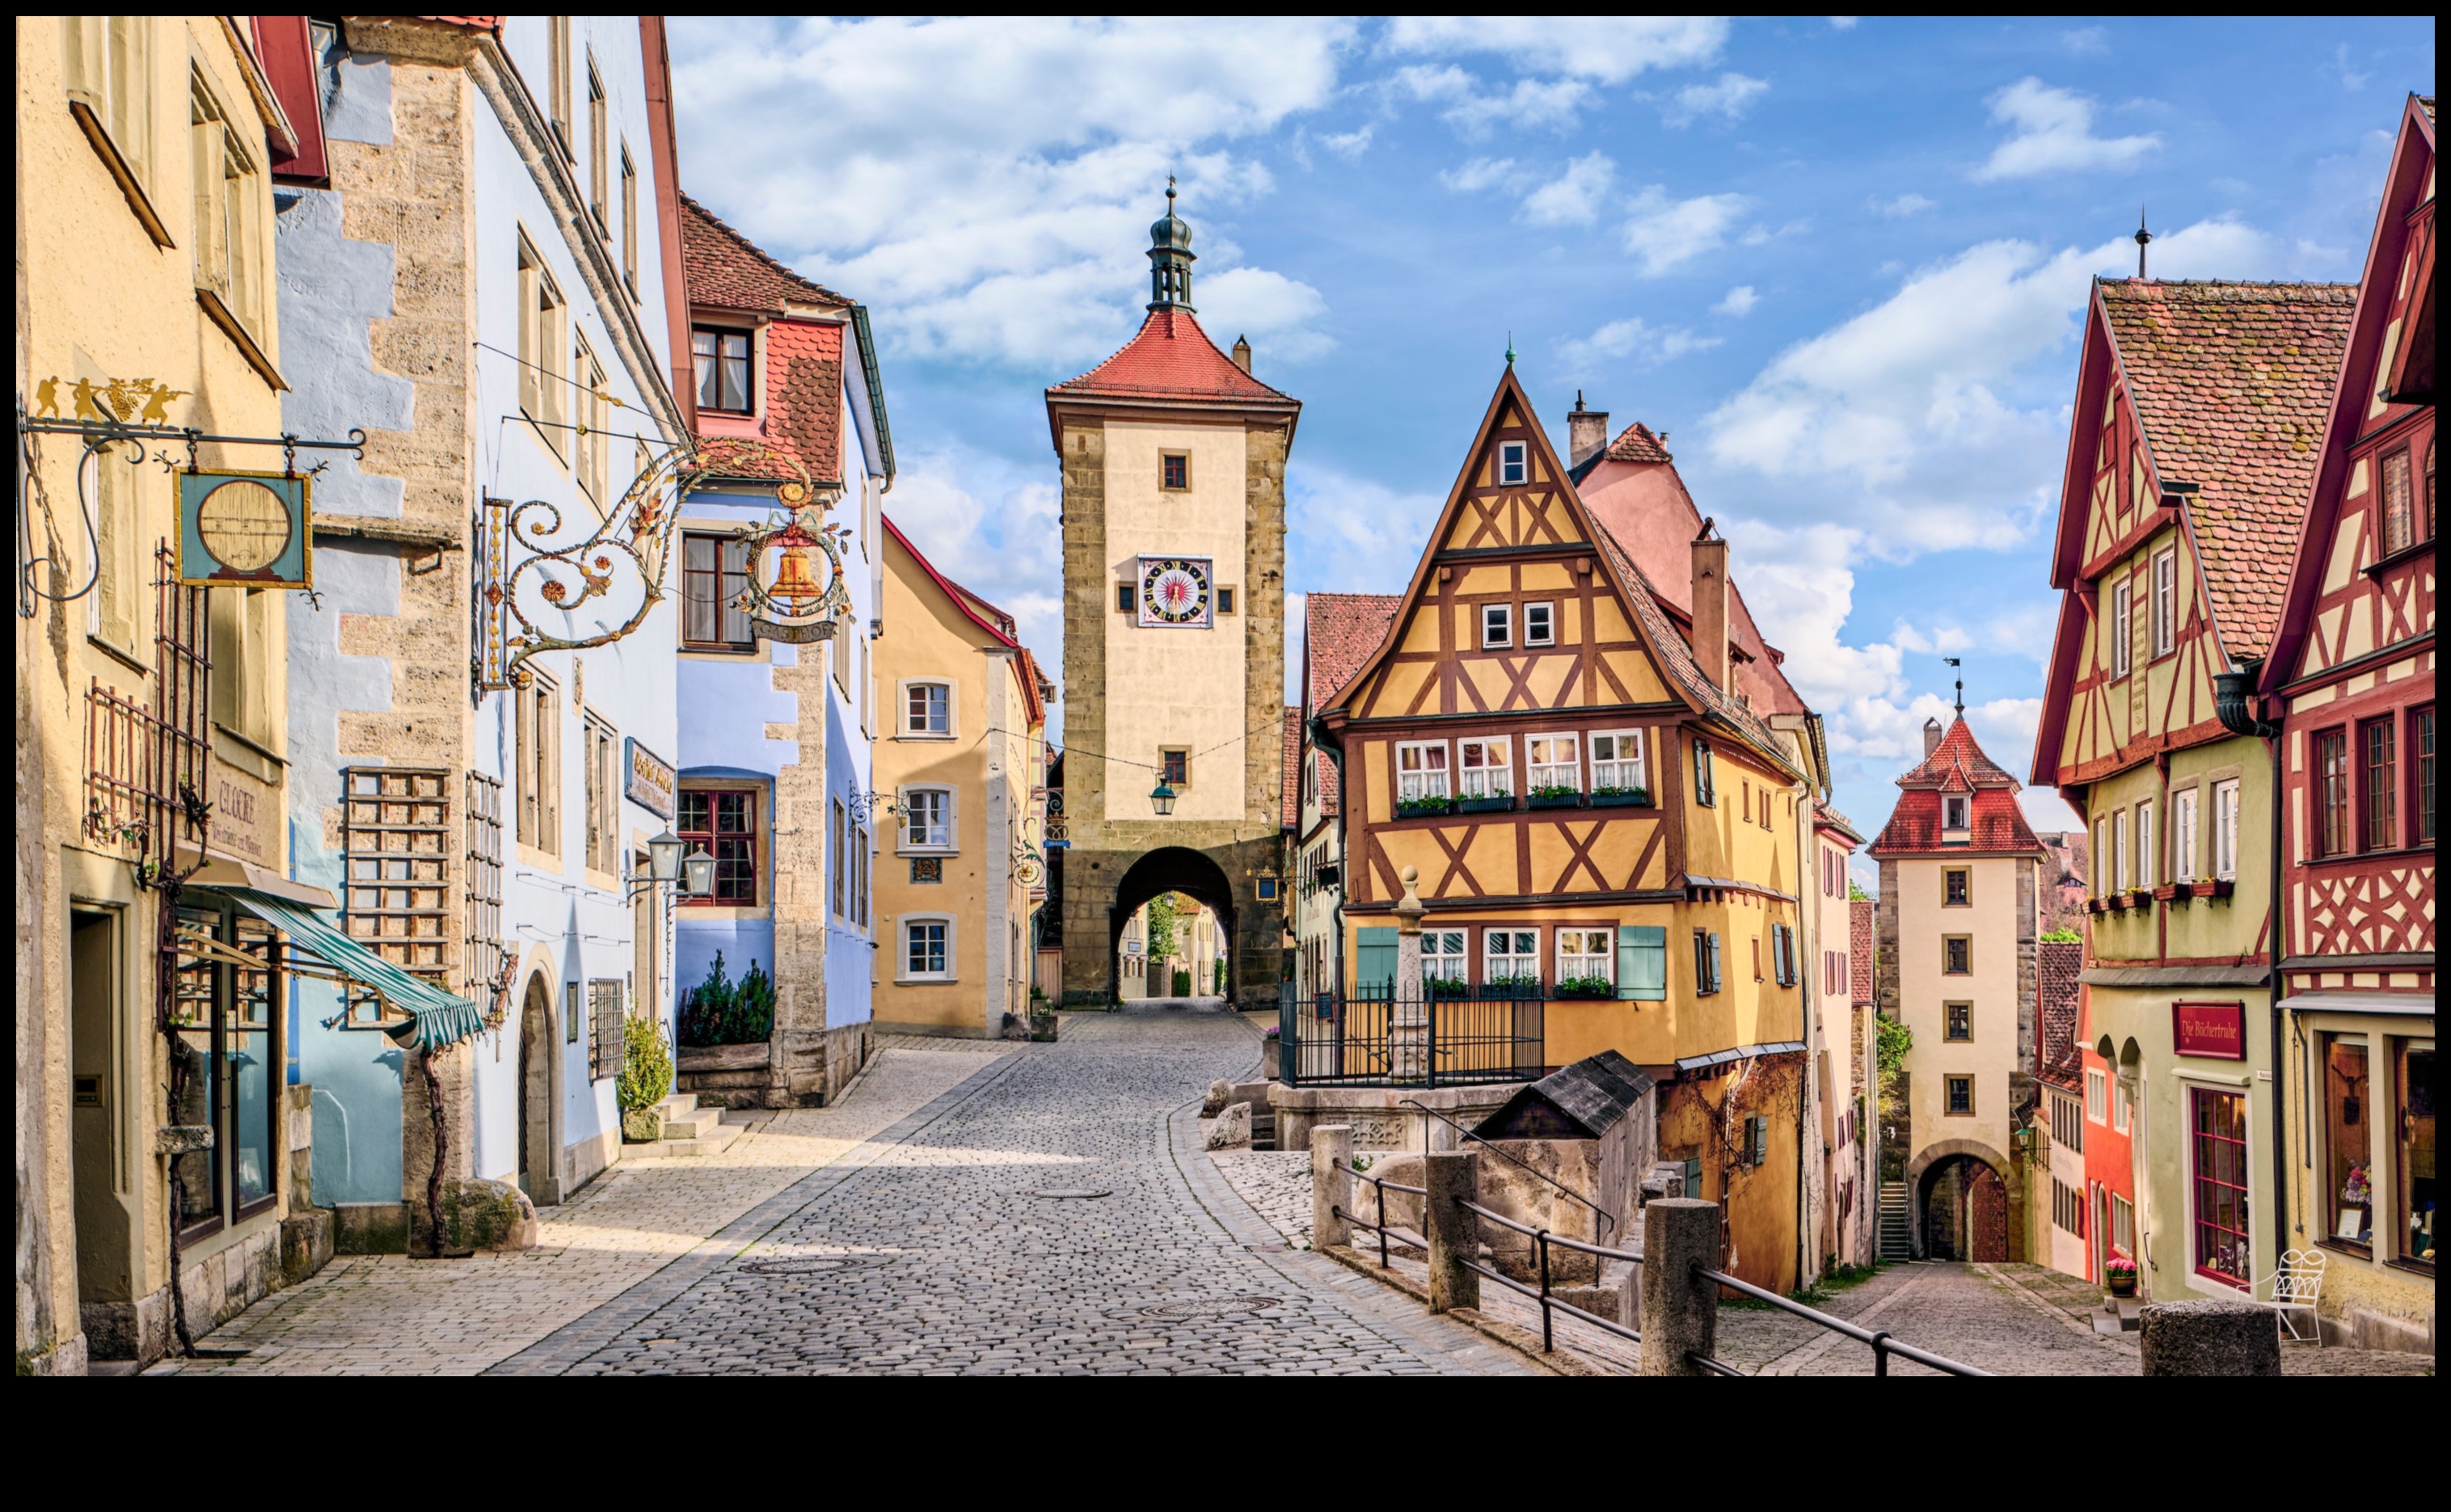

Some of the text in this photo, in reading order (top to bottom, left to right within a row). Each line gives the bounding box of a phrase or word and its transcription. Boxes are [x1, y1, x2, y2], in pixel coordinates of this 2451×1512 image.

[760, 623, 829, 639] GASTHOF
[219, 780, 255, 824] GLOCKE
[2182, 1020, 2237, 1039] Die Büchertruhe
